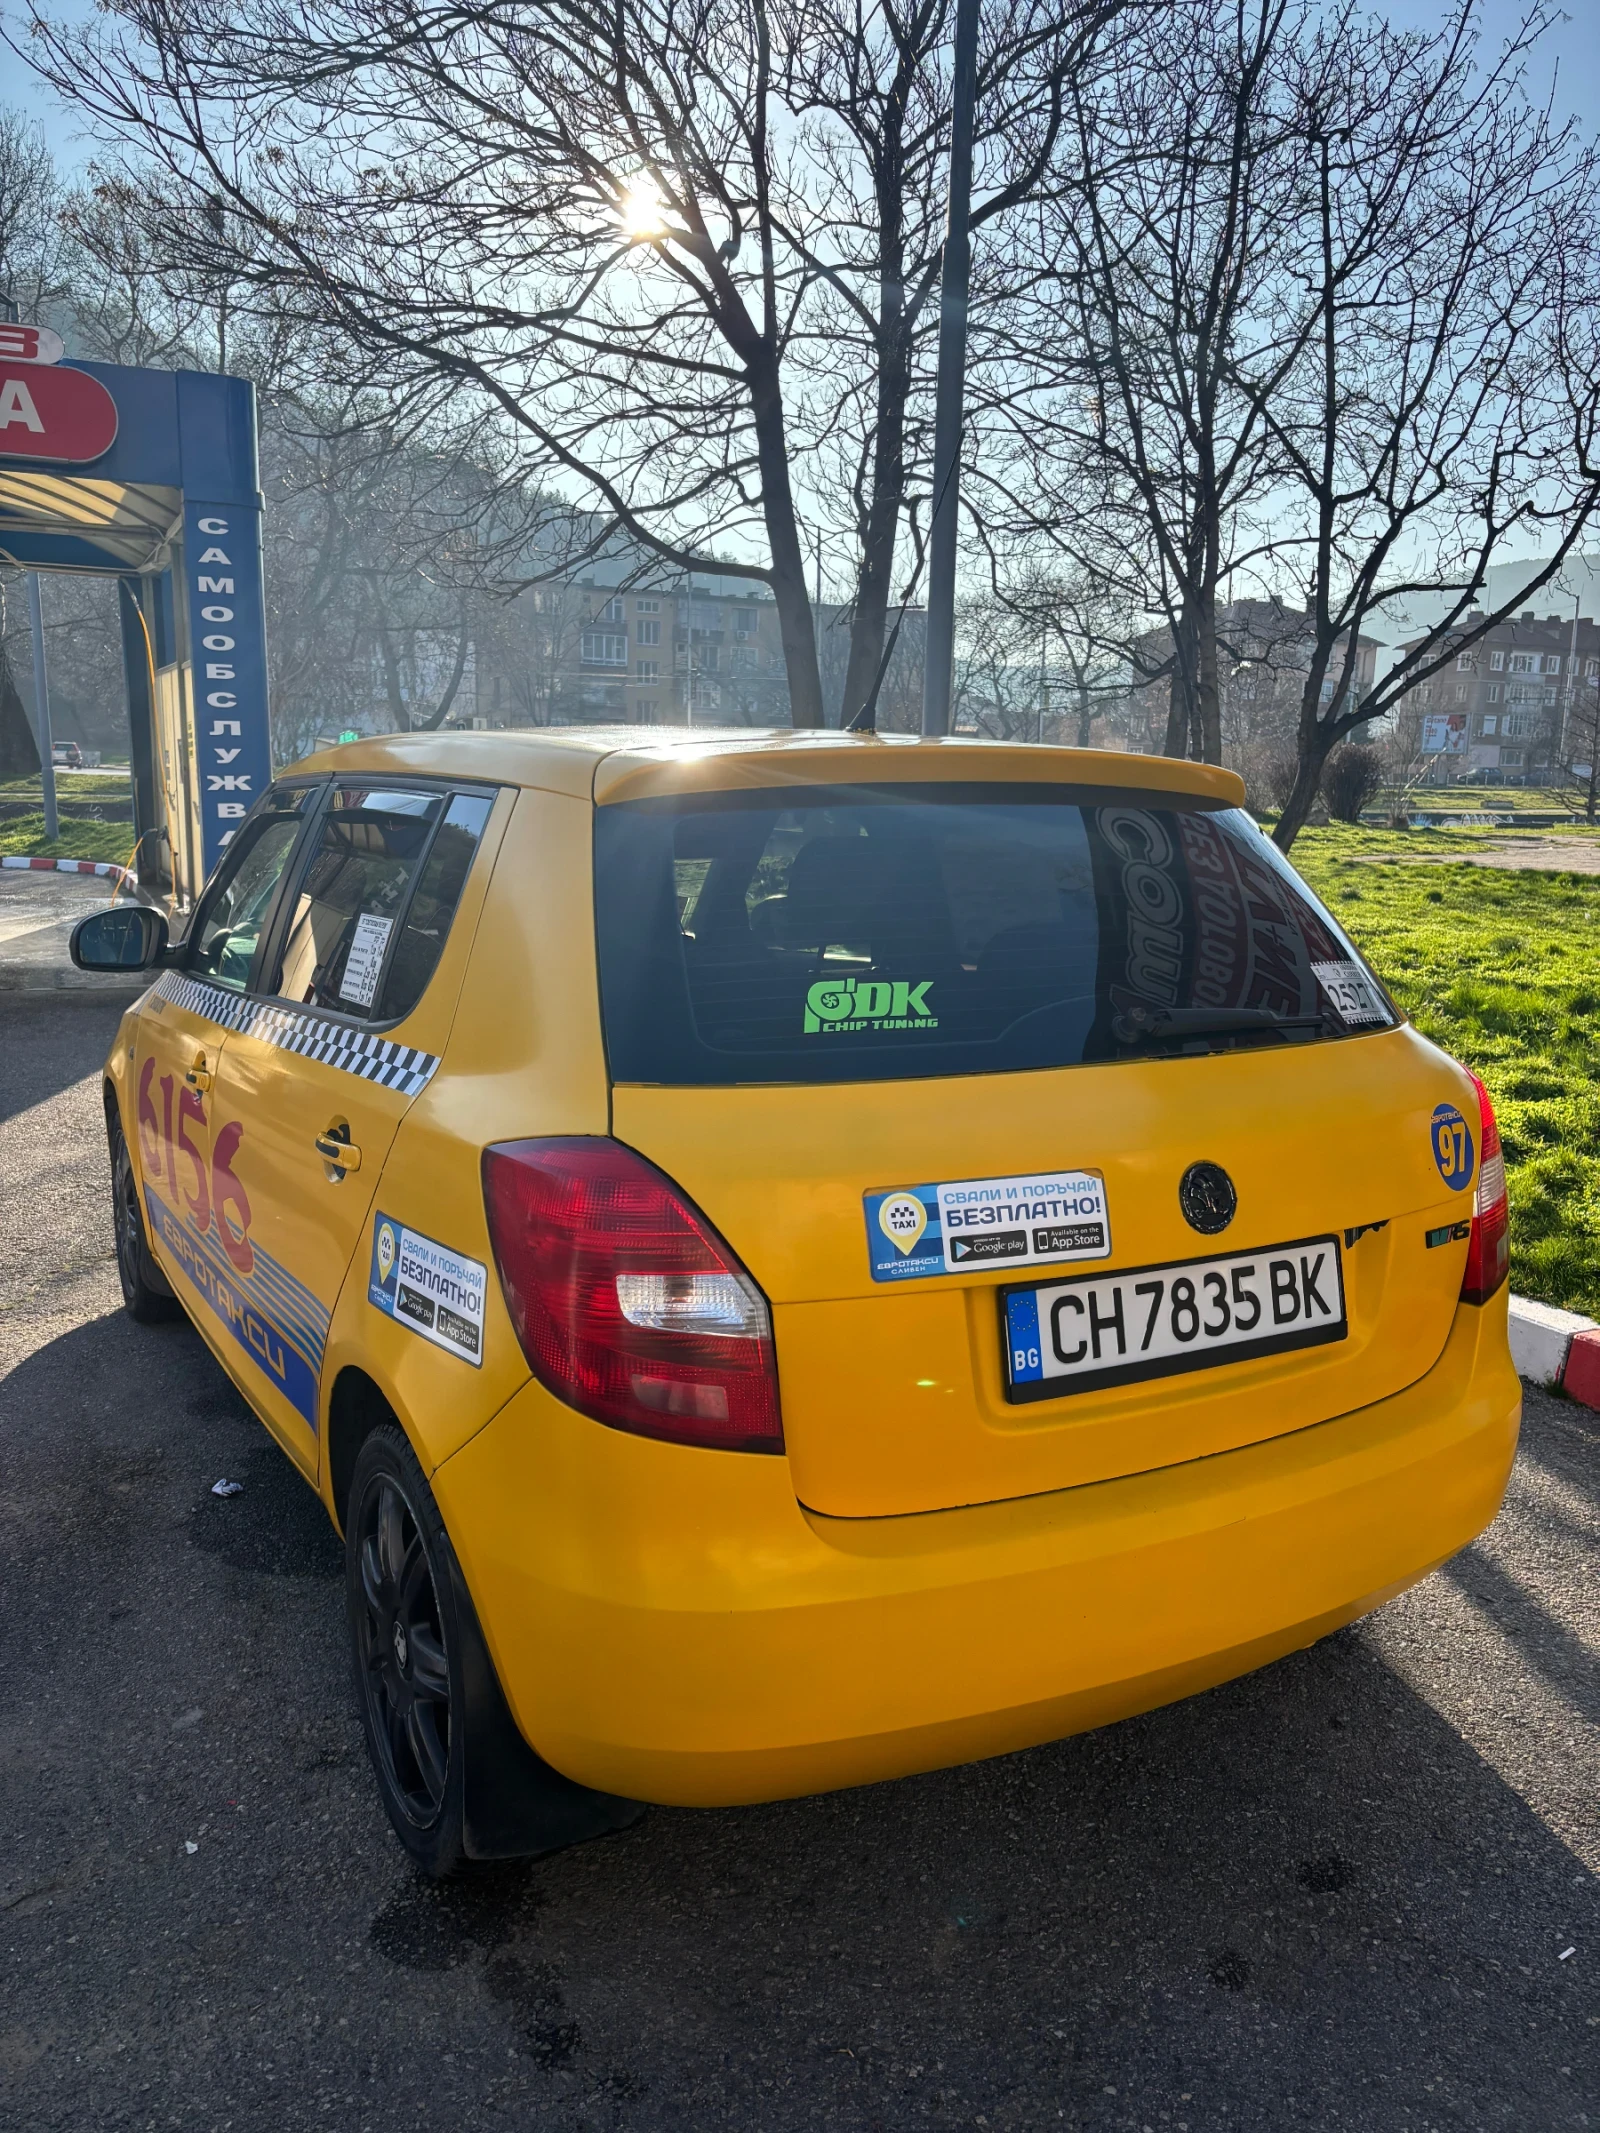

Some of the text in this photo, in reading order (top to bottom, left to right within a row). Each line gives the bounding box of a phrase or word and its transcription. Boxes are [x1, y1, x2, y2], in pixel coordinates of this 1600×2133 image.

[822, 1020, 868, 1033] CHIP
[1438, 1121, 1467, 1177] 97
[139, 1057, 254, 1274] 6156
[943, 1176, 1098, 1206] СВАЛИ И ПОРЪЧАЙ
[891, 1219, 917, 1230] TAXI
[946, 1196, 1102, 1228] БЕЗПЛАТНО!
[1050, 1228, 1079, 1237] Available
[1089, 1226, 1099, 1234] the
[1051, 1234, 1101, 1249] App Store
[973, 1240, 1006, 1254] Google
[1007, 1239, 1025, 1252] play
[402, 1238, 482, 1290] СВАЛИ И ПОРЪЧАЙ
[400, 1255, 481, 1316] БЕЗПЛАТНО!
[446, 1323, 477, 1348] App Store
[1014, 1348, 1039, 1371] BG
